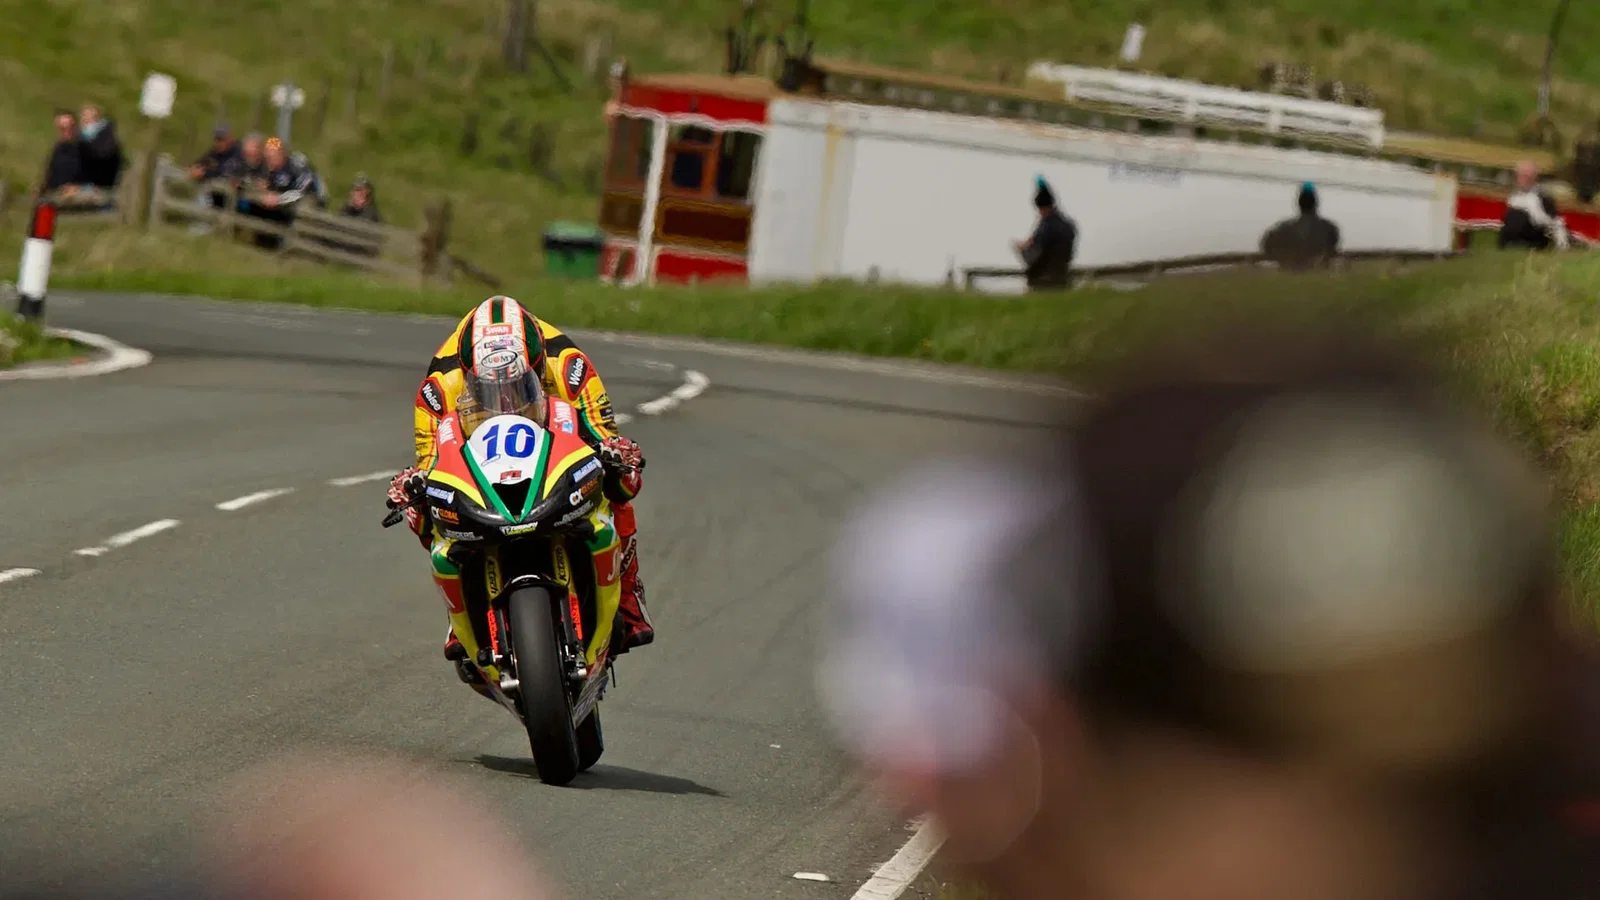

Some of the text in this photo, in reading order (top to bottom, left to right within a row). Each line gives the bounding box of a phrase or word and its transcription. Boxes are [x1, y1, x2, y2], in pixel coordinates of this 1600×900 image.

[485, 326, 509, 335] SWAN
[569, 357, 584, 386] Weise
[422, 383, 442, 412] Weise
[481, 423, 536, 466] 10
[569, 488, 584, 506] CX
